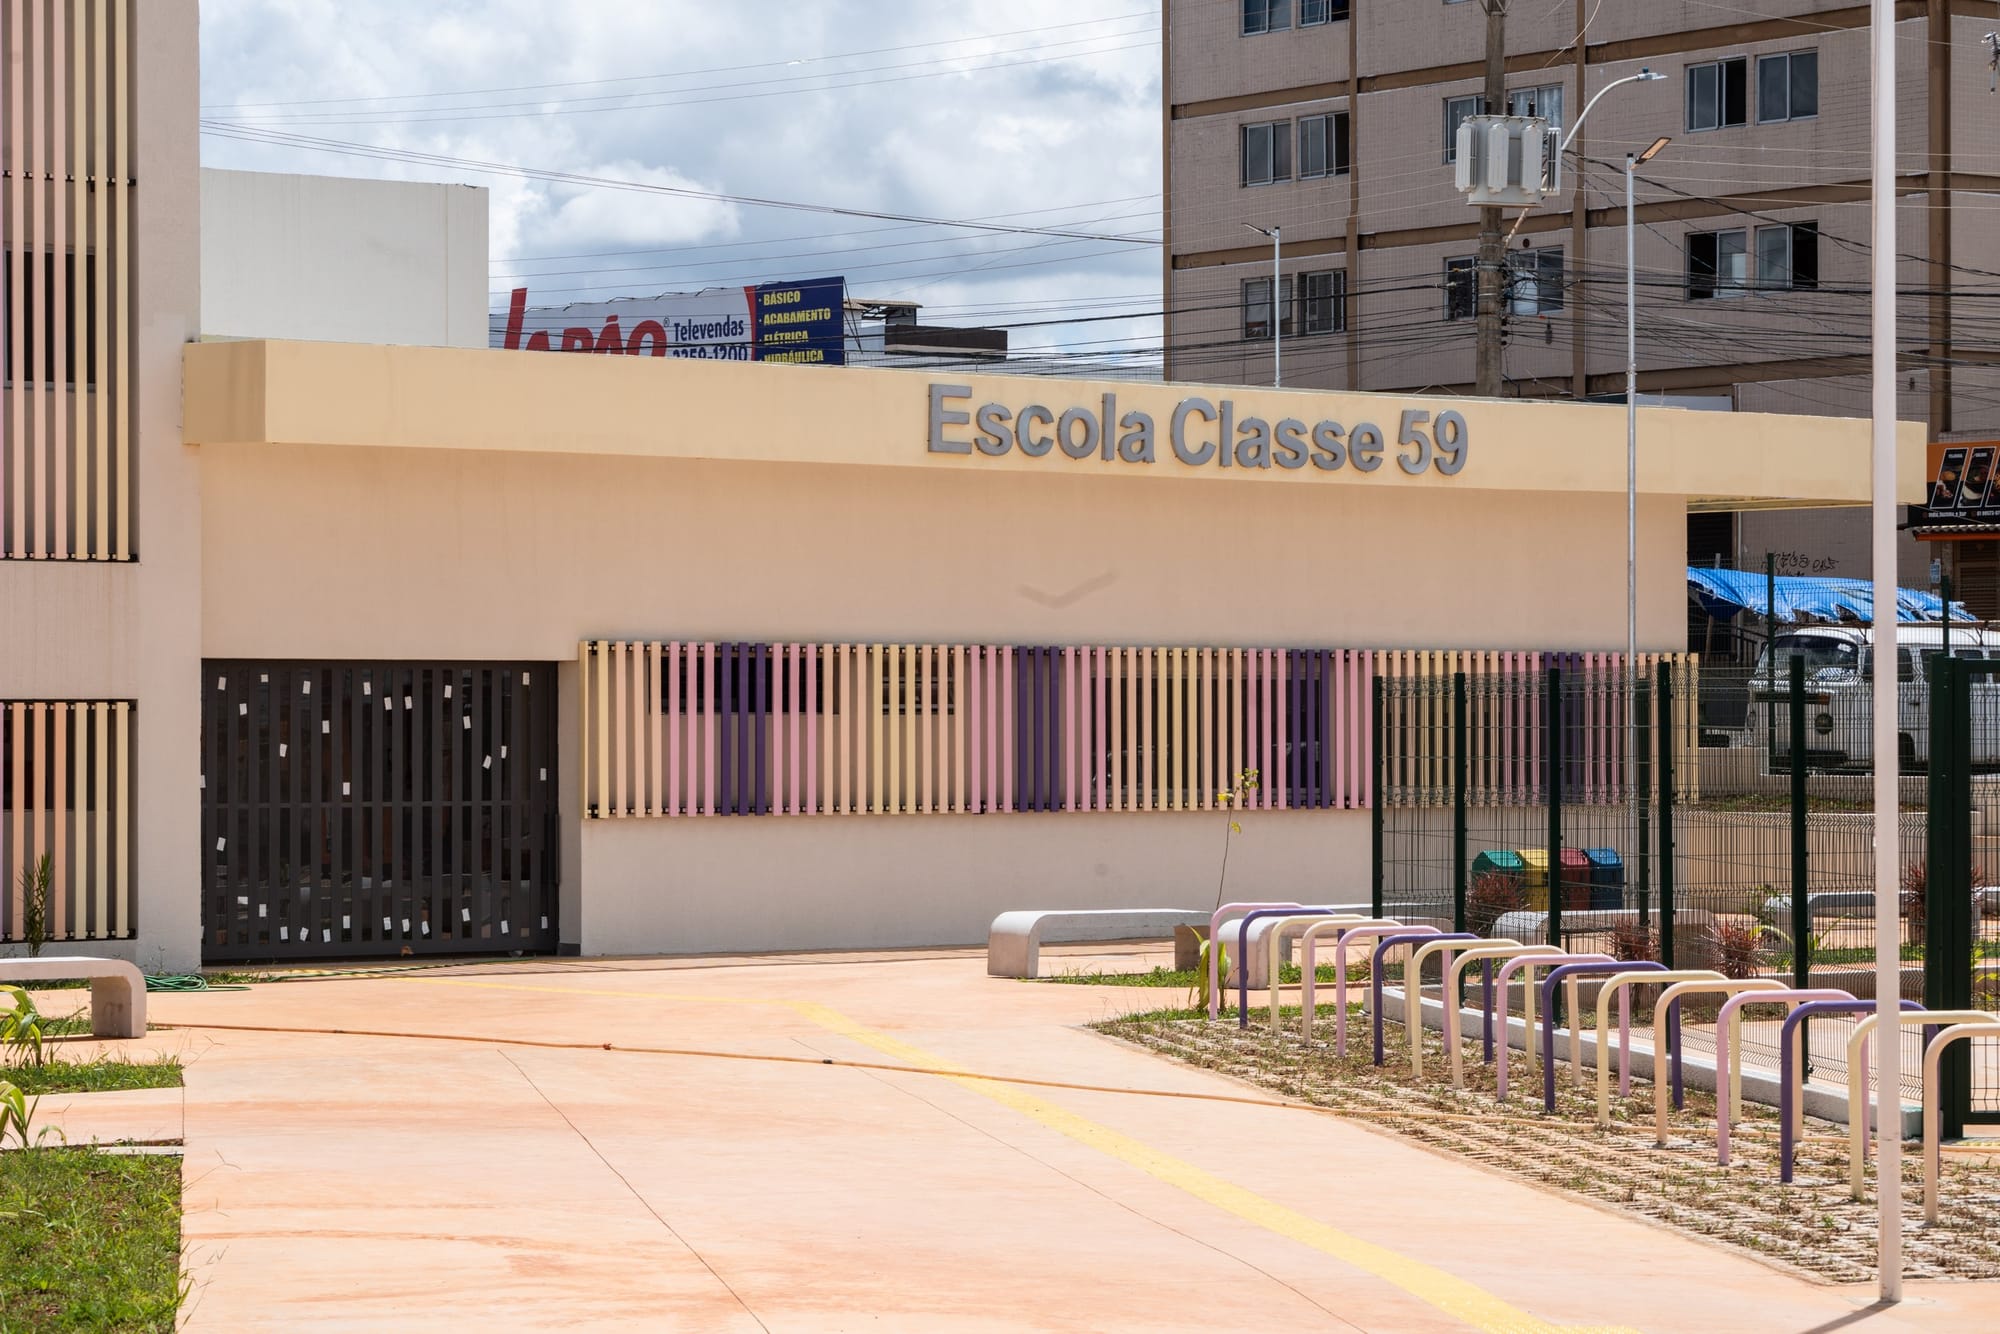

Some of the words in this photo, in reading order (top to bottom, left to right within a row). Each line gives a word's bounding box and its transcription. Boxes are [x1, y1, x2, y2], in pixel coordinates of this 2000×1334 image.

[763, 290, 801, 306] BÁSICO
[763, 308, 831, 326] ACABAMENTO
[674, 314, 744, 342] Televendas
[763, 330, 809, 346] ELÉTRICA
[763, 349, 824, 363] HIDRÁULICA
[927, 383, 1156, 464] Escola
[1169, 396, 1385, 472] Classe
[1396, 408, 1469, 476] 59
